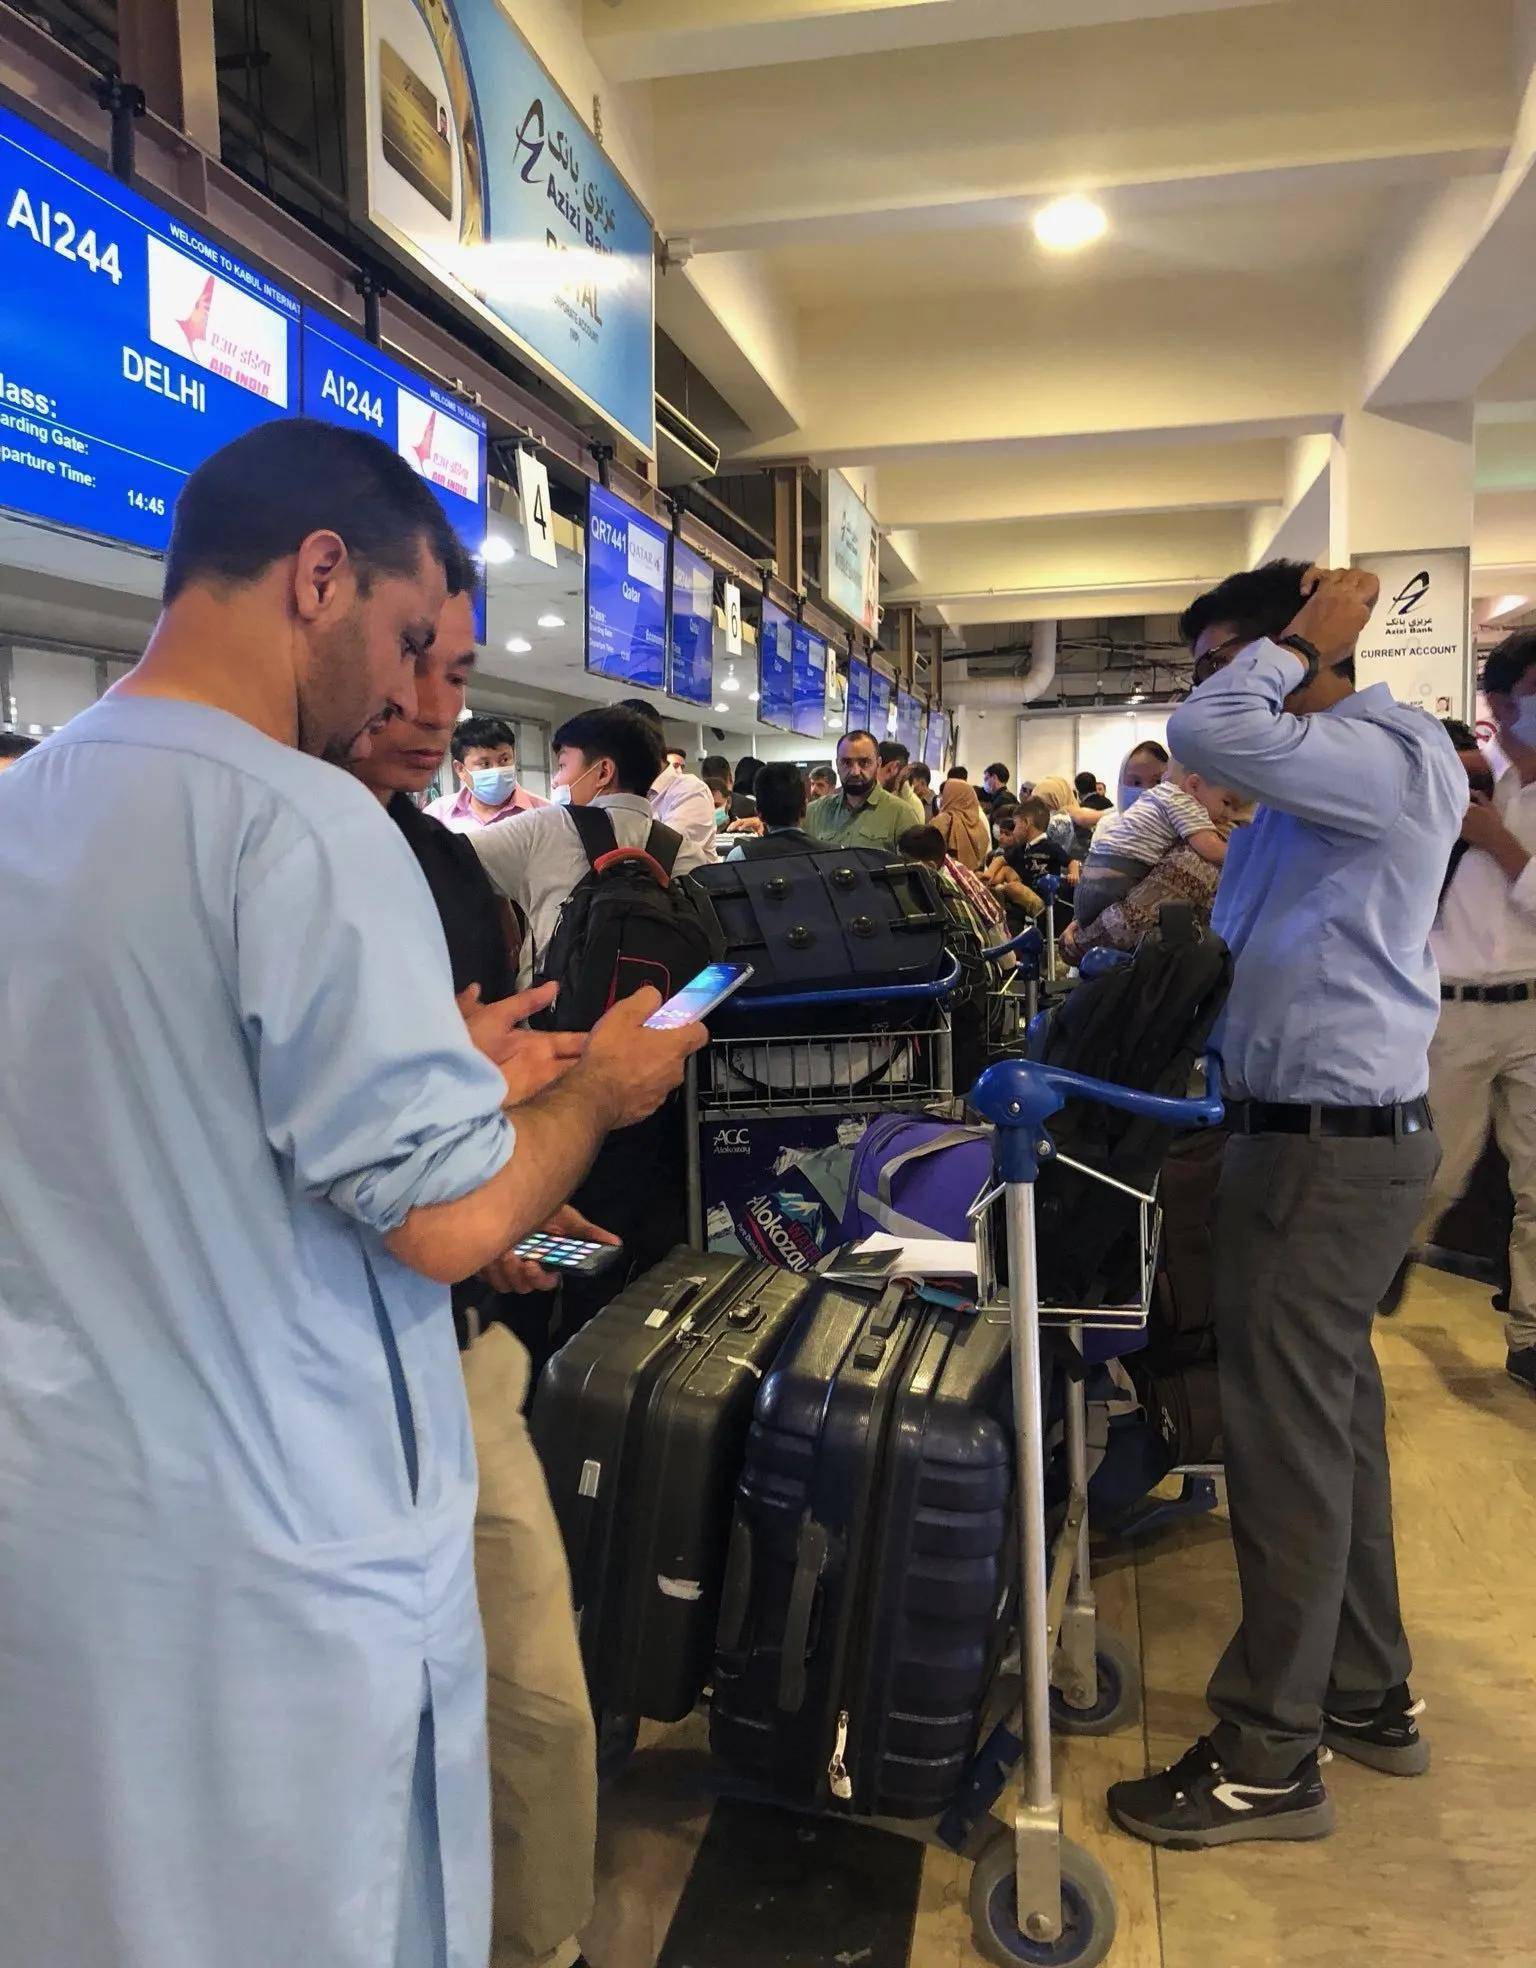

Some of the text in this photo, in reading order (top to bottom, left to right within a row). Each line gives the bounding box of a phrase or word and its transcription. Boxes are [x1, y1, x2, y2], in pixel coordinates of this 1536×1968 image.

[547, 172, 614, 257] Azizi Ba
[7, 187, 122, 286] AI244
[169, 222, 219, 263] WELCOME
[219, 254, 233, 271] TO
[233, 263, 262, 292] KABUL
[122, 345, 206, 413] DELHI
[209, 357, 270, 398] AIR INDIA
[321, 368, 384, 429] AI244
[429, 389, 457, 413] WELCOME
[51, 428, 89, 456] Gate:
[58, 460, 97, 489] Time:
[431, 471, 446, 487] AIR
[127, 489, 166, 516] 14:45
[533, 484, 547, 541] 4
[591, 515, 627, 554] QR7441
[629, 541, 655, 565] QATAR
[731, 602, 738, 639] 6
[1385, 626, 1433, 636] Azizi Bank
[1360, 645, 1458, 659] CURRENT ACCOUNT
